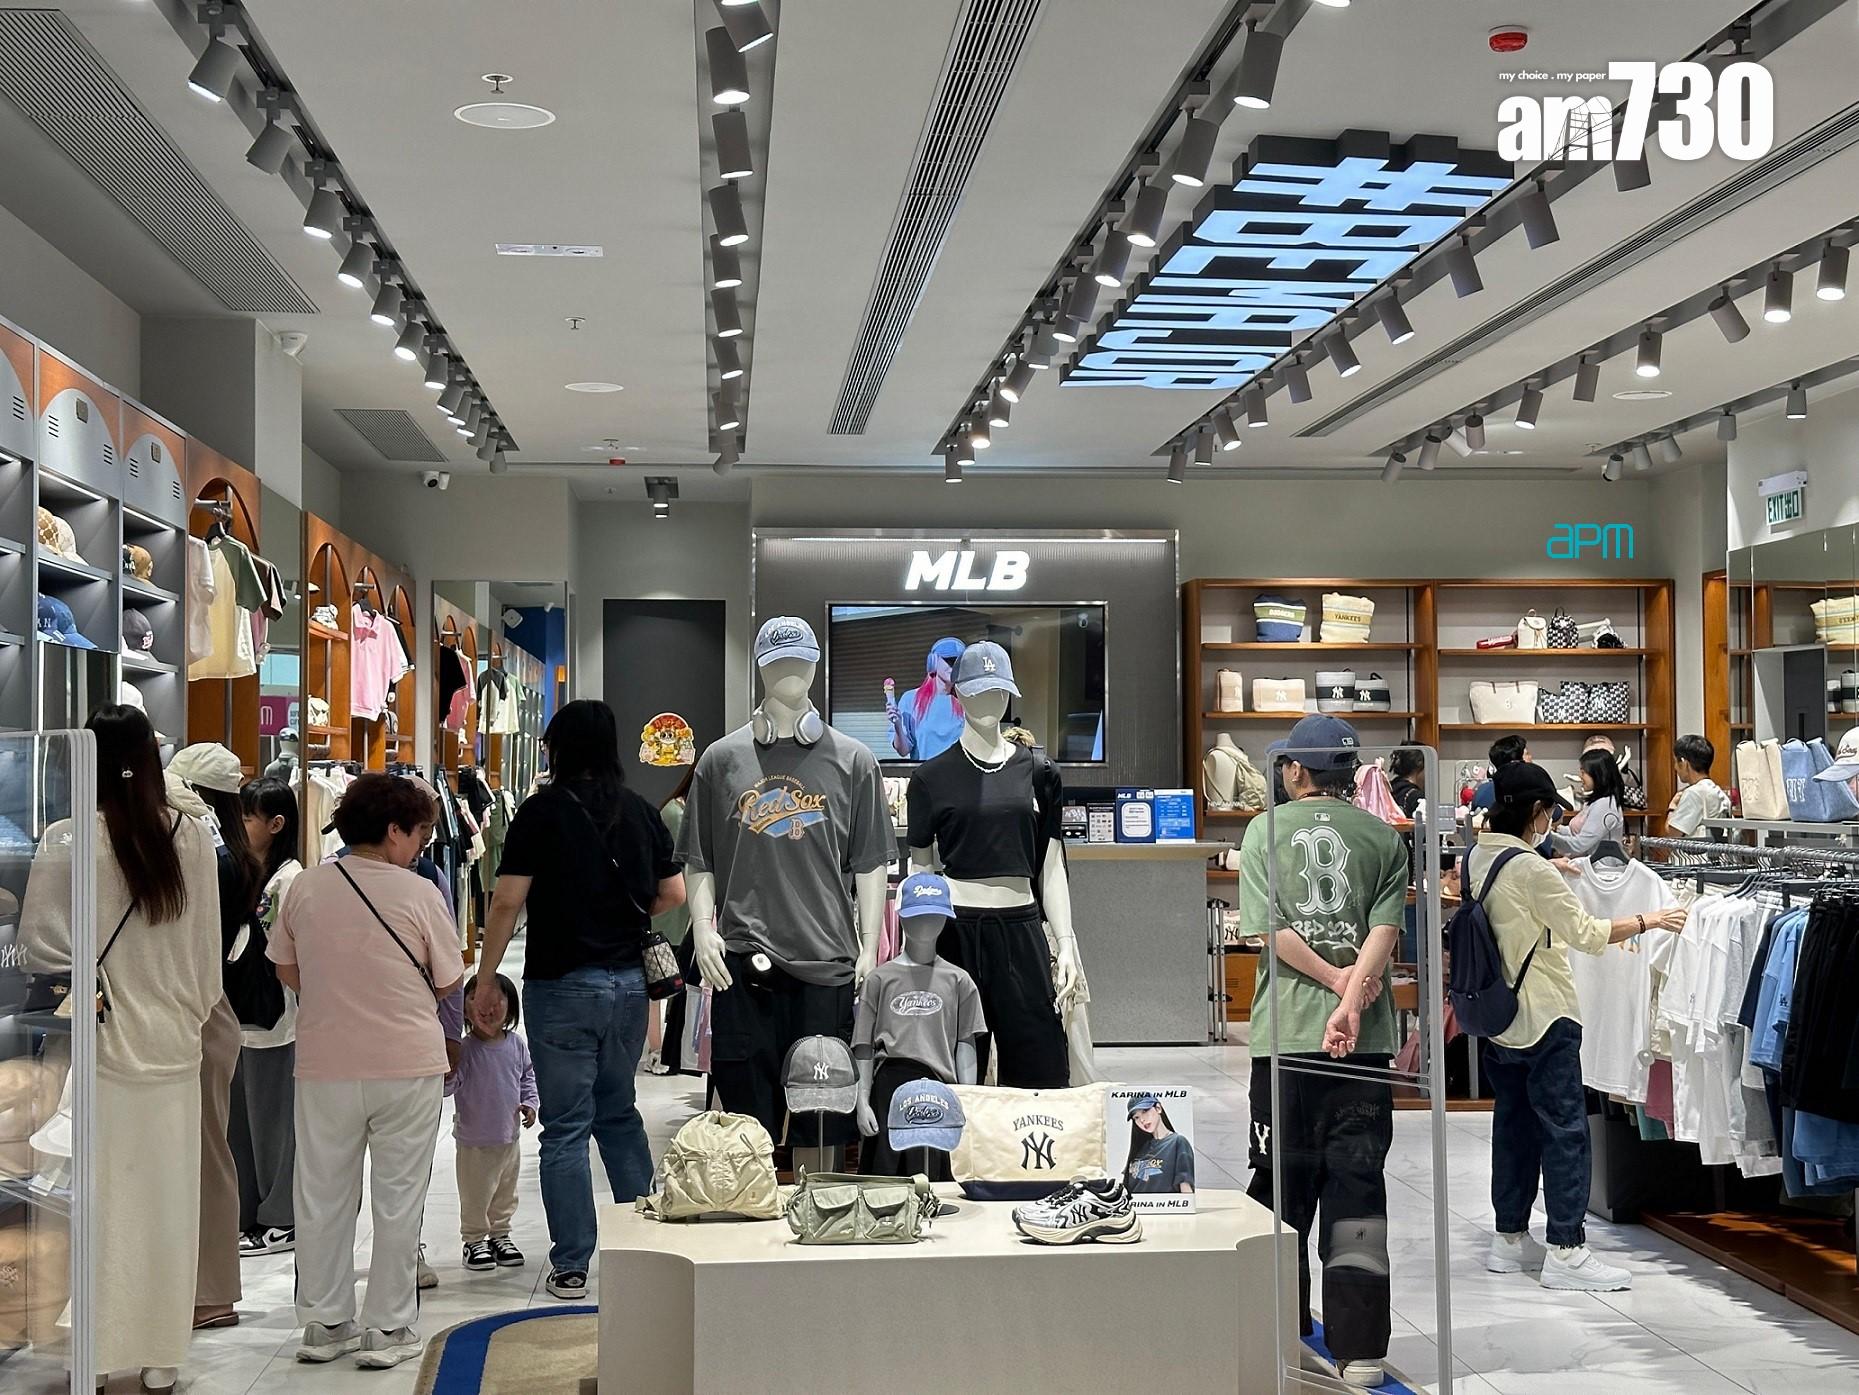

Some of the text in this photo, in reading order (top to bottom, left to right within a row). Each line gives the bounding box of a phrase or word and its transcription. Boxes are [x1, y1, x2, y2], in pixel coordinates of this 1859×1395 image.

[1767, 495, 1785, 524] EXIT
[1784, 489, 1799, 520] 出口
[904, 550, 1031, 591] MLB
[1334, 613, 1361, 623] YANKEES
[982, 656, 997, 673] LA
[785, 789, 827, 812] Sox
[1291, 825, 1352, 916] B
[1292, 918, 1325, 941] RED
[813, 1061, 829, 1081] NY
[900, 1094, 949, 1112] LOS ANGELES
[1111, 1091, 1152, 1099] KARINA
[1164, 1090, 1188, 1098] MLB
[1013, 1114, 1065, 1131] YANKEES
[1021, 1131, 1057, 1170] NY
[1167, 1200, 1189, 1208] MLB
